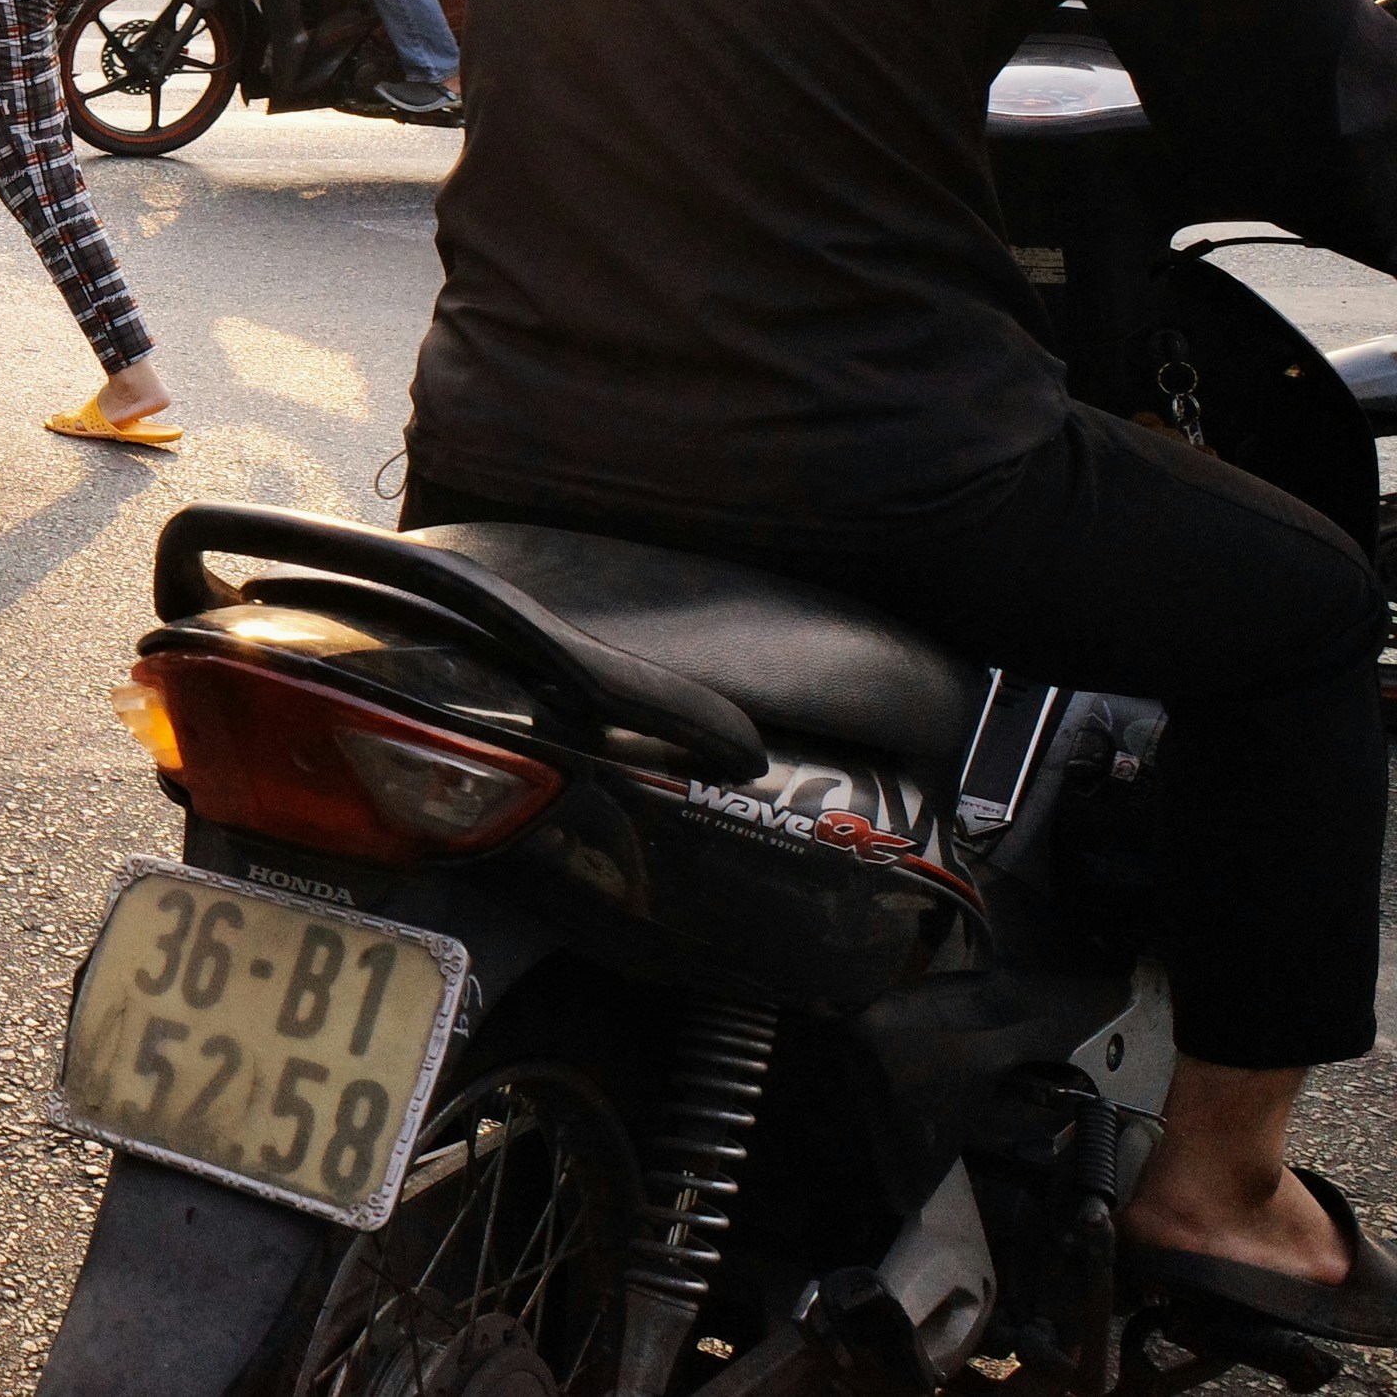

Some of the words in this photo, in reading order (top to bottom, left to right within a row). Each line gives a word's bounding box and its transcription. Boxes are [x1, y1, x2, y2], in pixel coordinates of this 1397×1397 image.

[681, 809, 710, 824] CITY
[715, 820, 764, 841] FASHION
[770, 837, 805, 855] MOVER
[247, 864, 356, 906] HONDA
[134, 889, 398, 1057] 36-B1
